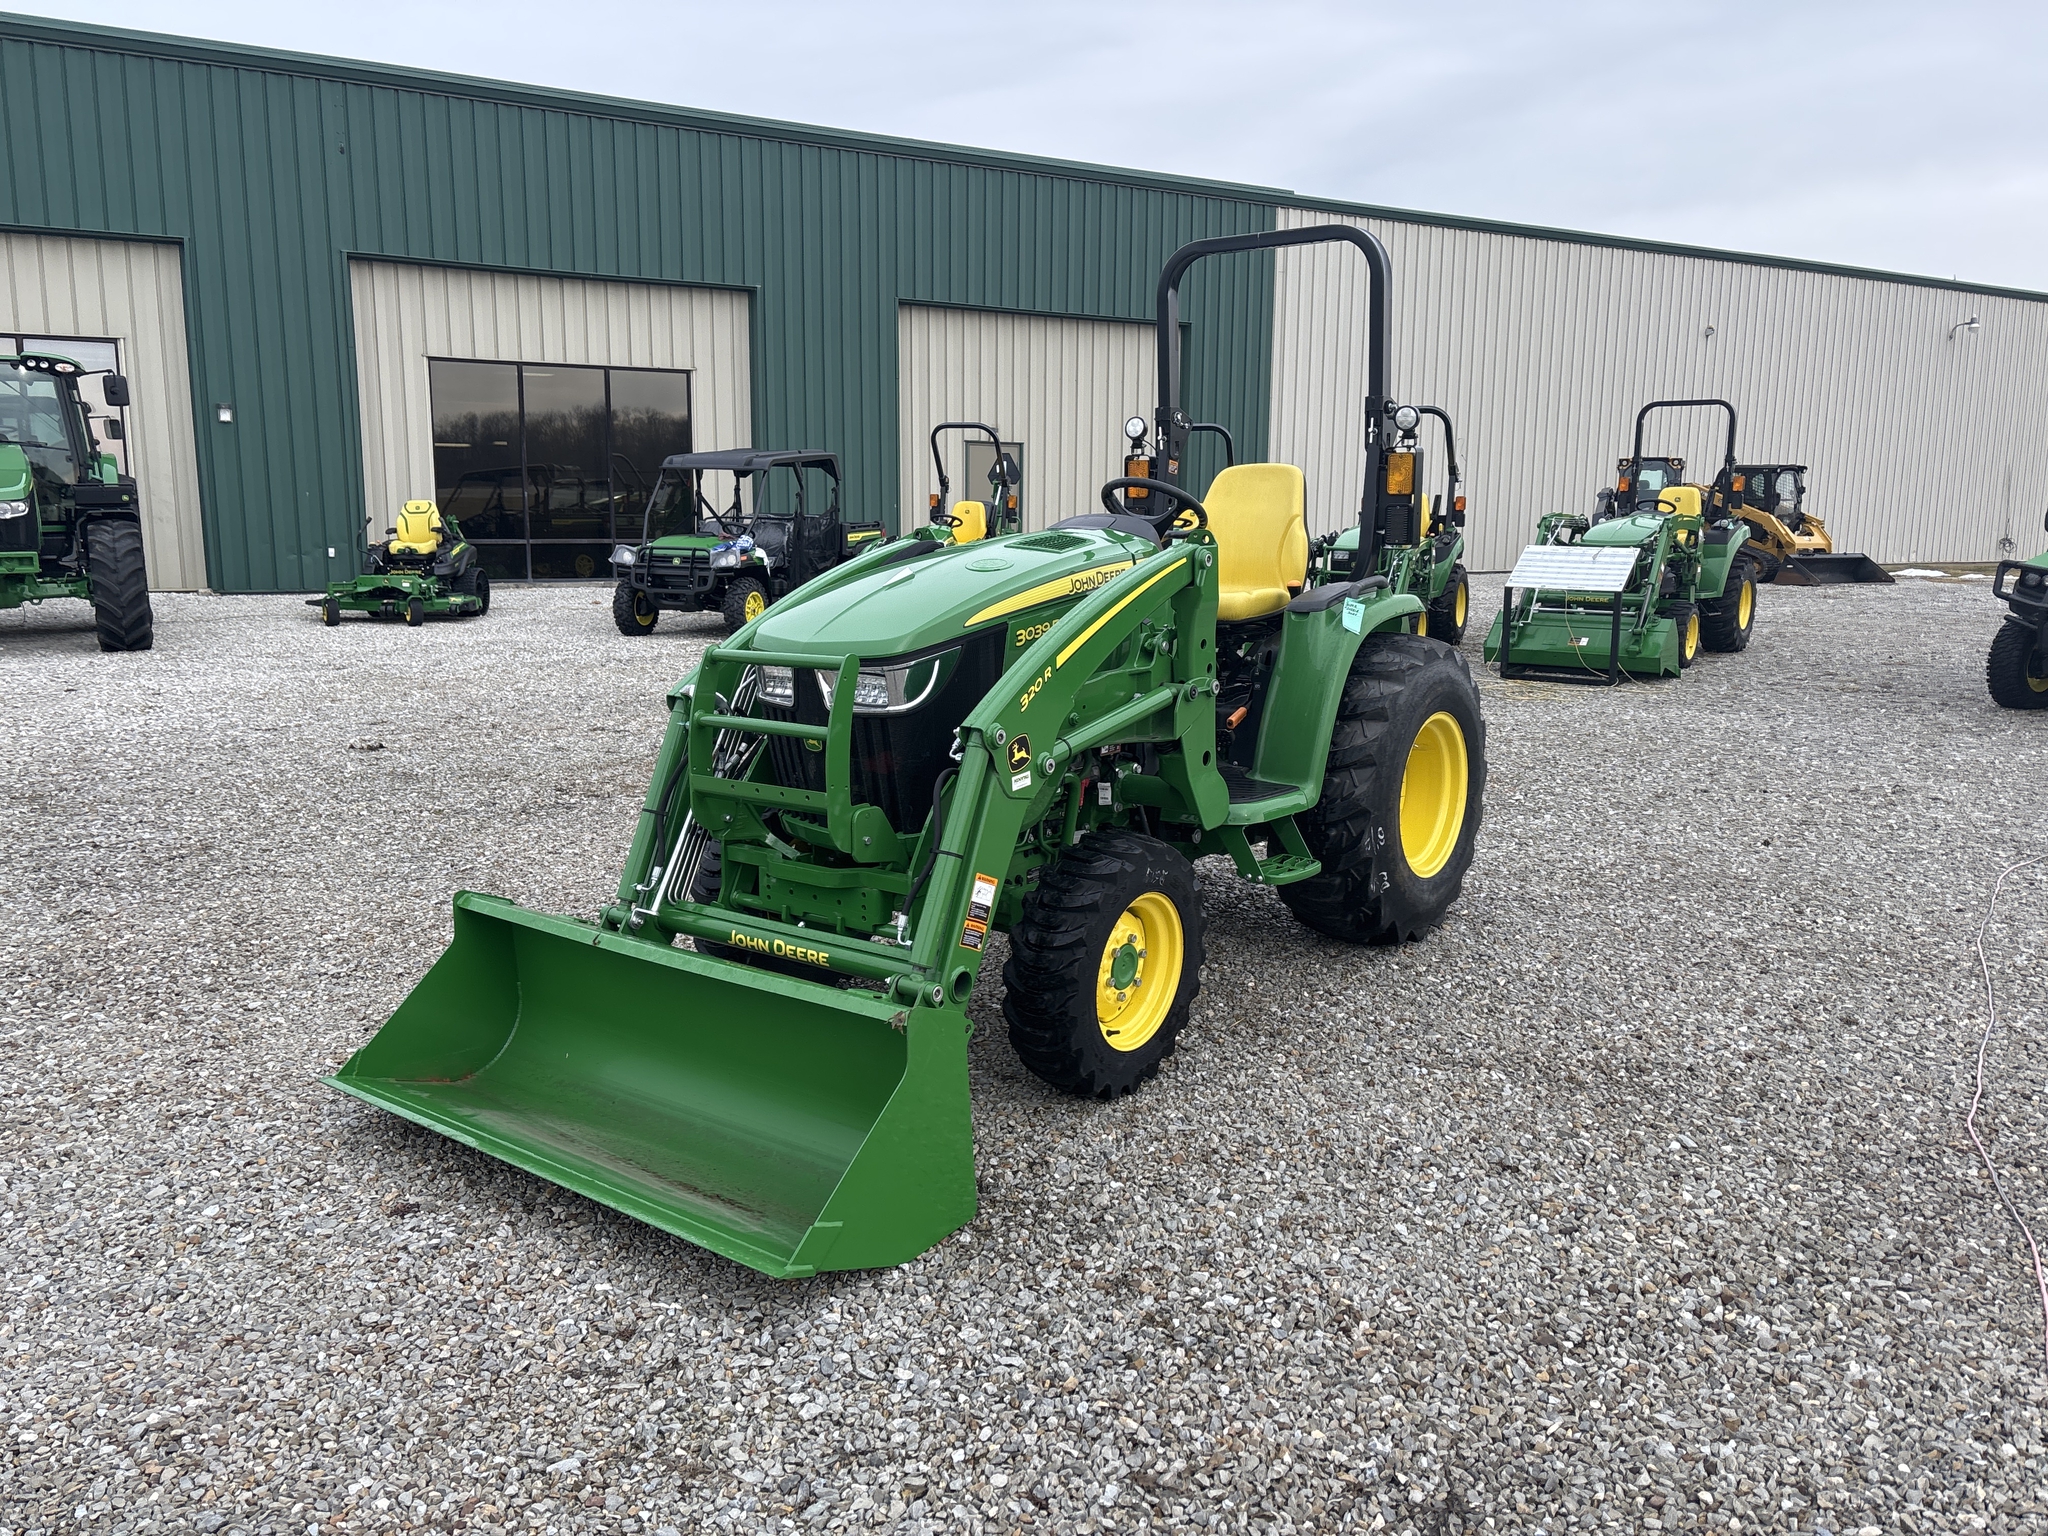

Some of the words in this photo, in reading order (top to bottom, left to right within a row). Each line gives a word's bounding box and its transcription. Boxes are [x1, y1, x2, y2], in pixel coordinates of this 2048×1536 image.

[1068, 574, 1096, 593] JOHN
[1096, 568, 1126, 586] DEER
[1585, 595, 1609, 603] DEERE
[1016, 622, 1050, 646] 3039
[1020, 676, 1043, 713] 320
[1044, 665, 1052, 683] R
[727, 929, 770, 953] JOHN
[773, 938, 830, 967] DEERE
